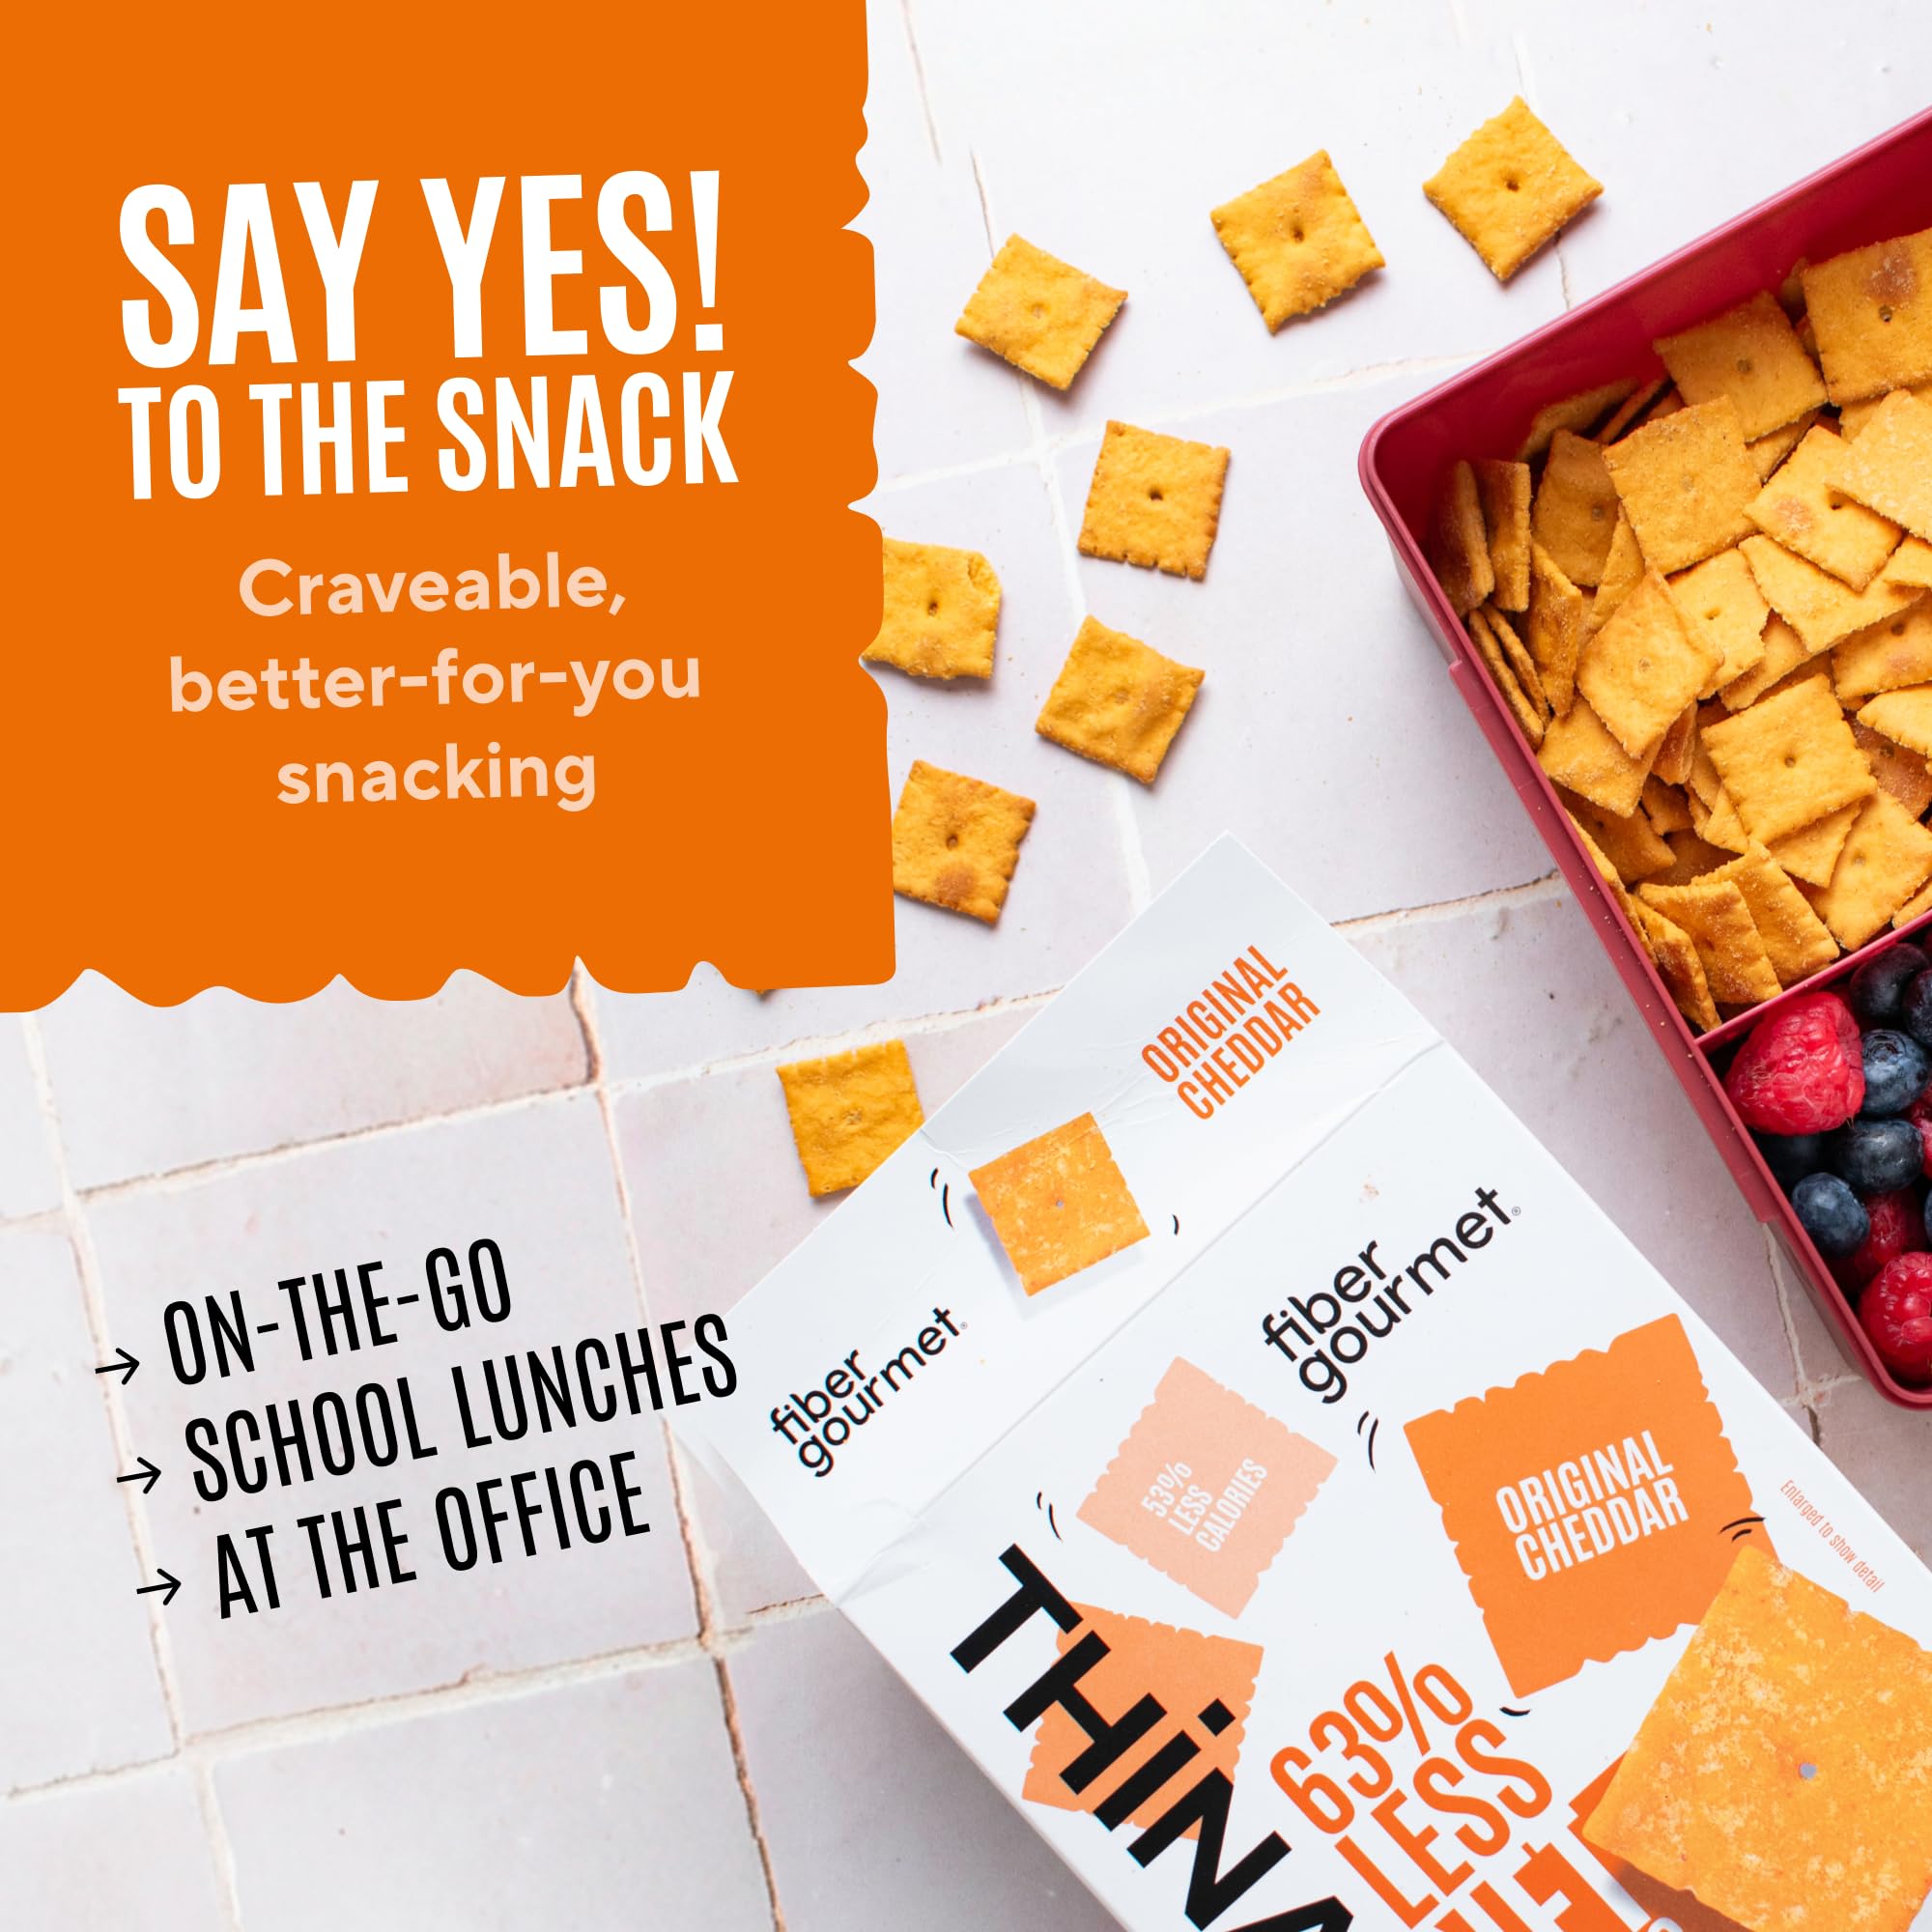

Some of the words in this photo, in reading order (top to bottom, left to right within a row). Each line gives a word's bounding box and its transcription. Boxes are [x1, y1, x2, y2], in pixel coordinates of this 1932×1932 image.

[1141, 945, 1289, 1083] ORIGINAL
[1177, 981, 1321, 1120] CHEDDAR
[1262, 1239, 1387, 1362] fiber
[770, 1349, 867, 1445] fiber
[1141, 1461, 1193, 1519] 53%
[1168, 1484, 1213, 1537] LESS
[1195, 1457, 1268, 1552] CALORIES
[1496, 1429, 1674, 1534] ORIGINAL
[1515, 1476, 1690, 1581] CHEDDAR
[1779, 1479, 1825, 1527] Enlarged
[1818, 1521, 1833, 1539] to
[1829, 1534, 1858, 1564] show
[1852, 1560, 1886, 1593] detail
[1269, 1650, 1474, 1835] 63%
[1333, 1719, 1552, 1930] LESS
